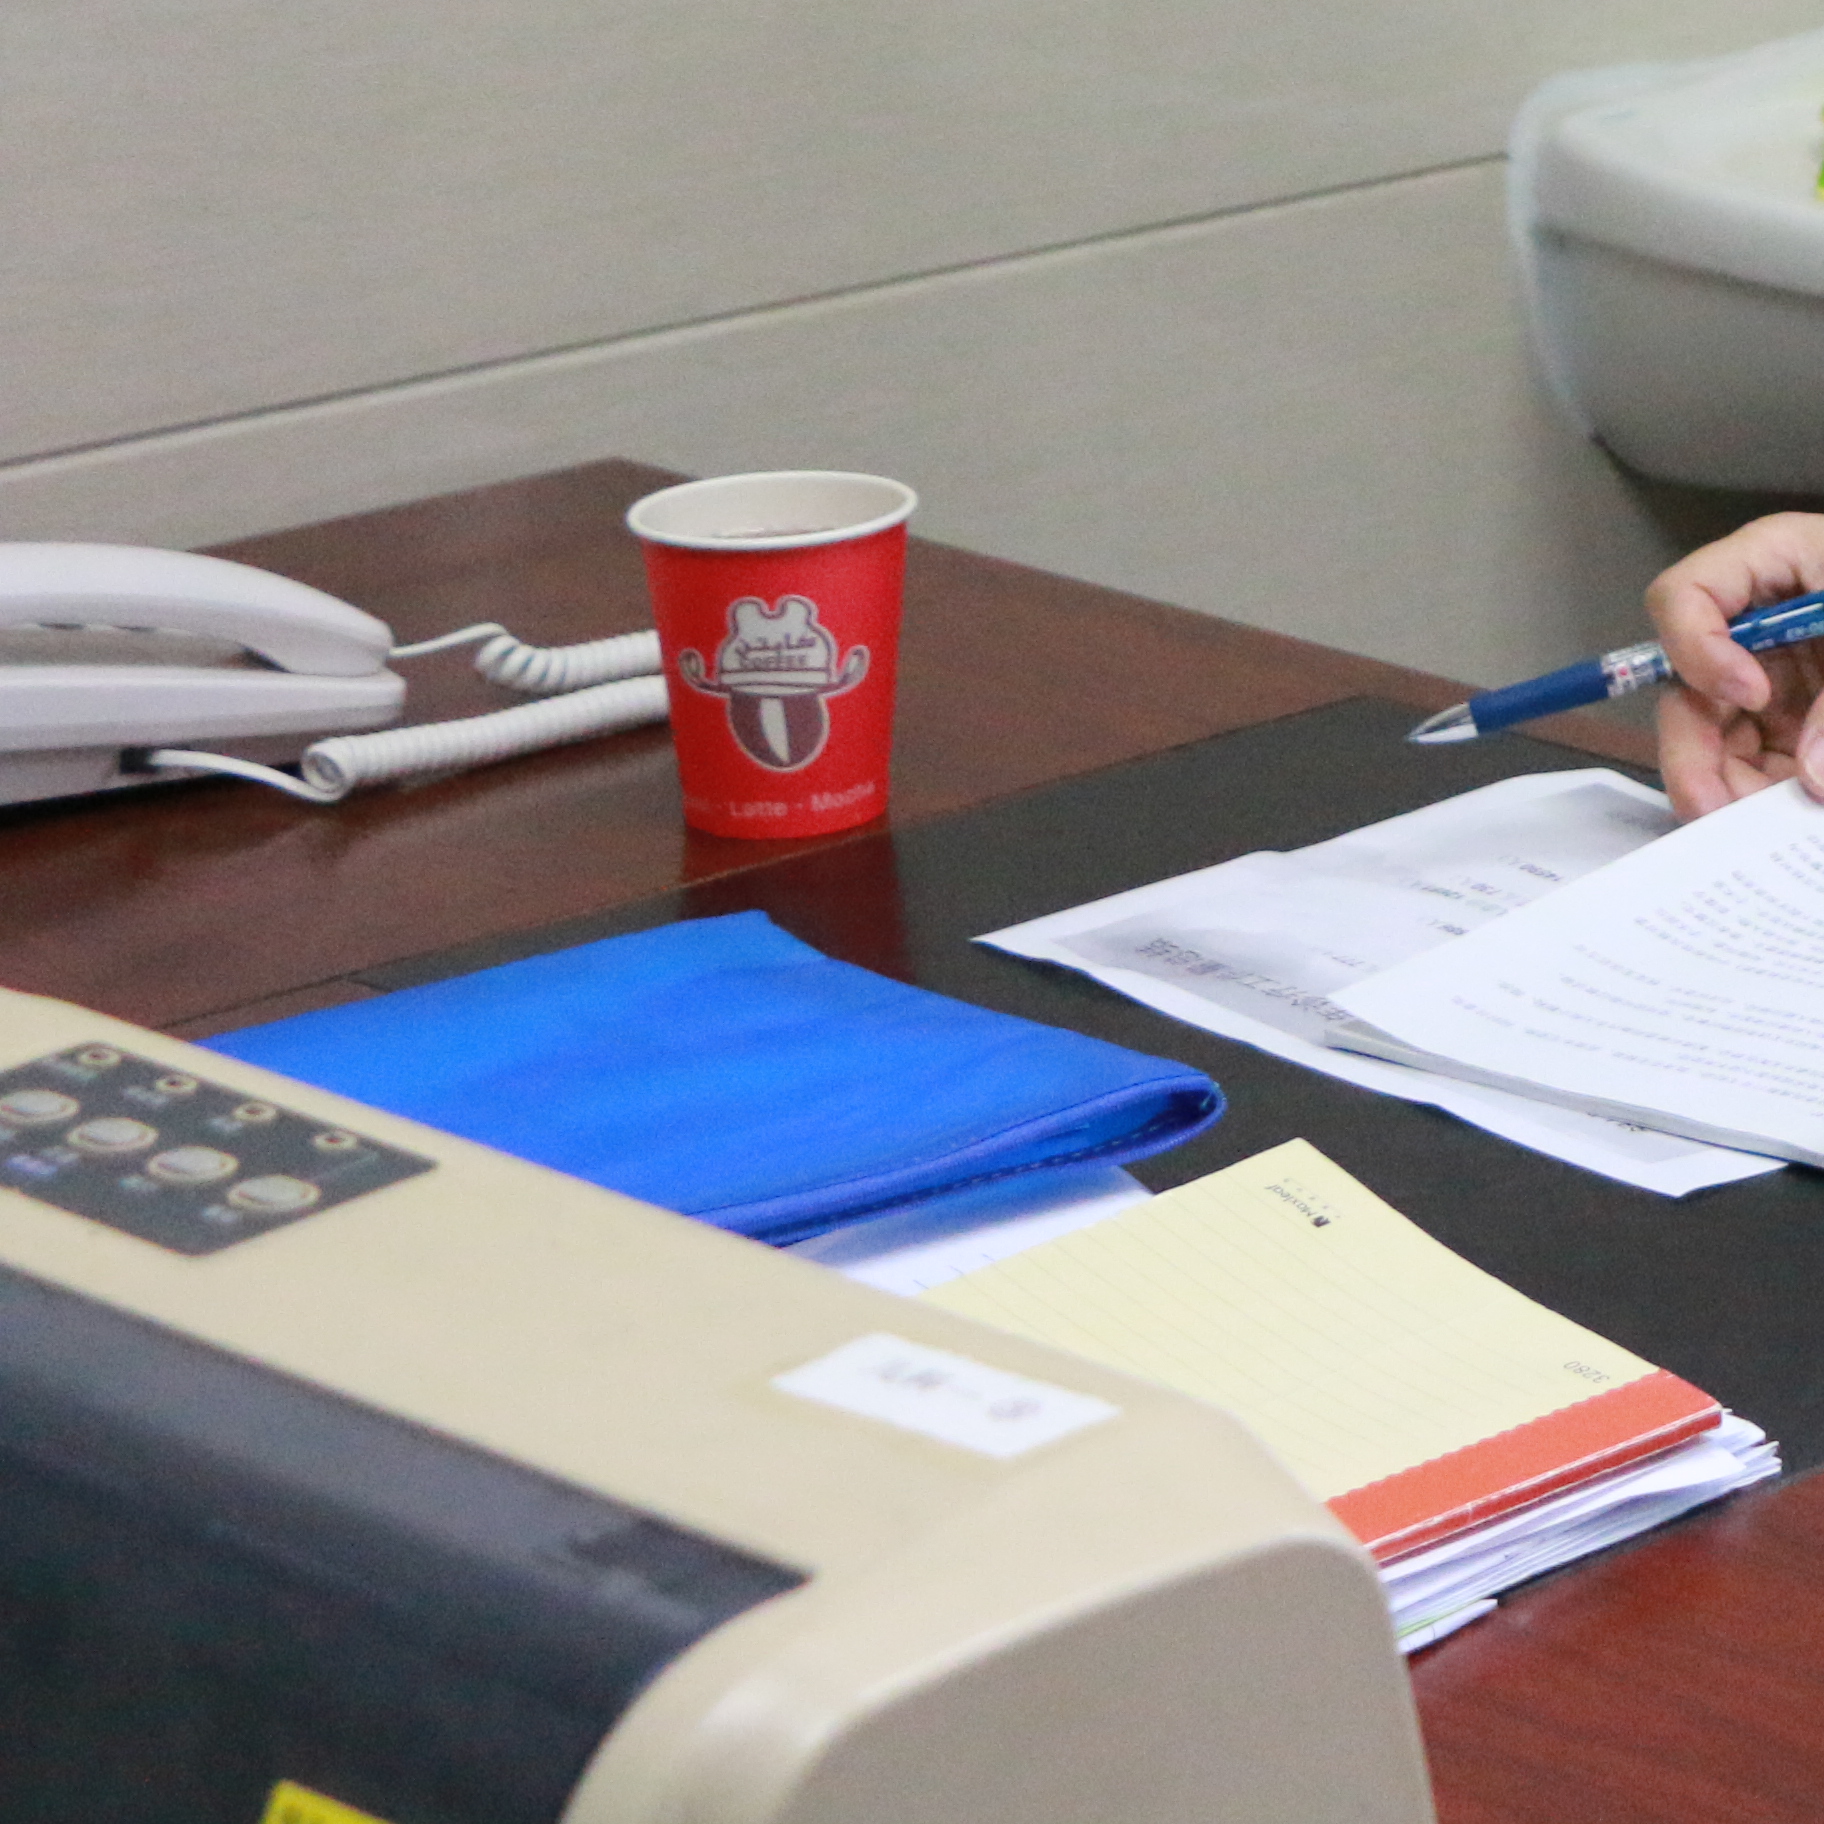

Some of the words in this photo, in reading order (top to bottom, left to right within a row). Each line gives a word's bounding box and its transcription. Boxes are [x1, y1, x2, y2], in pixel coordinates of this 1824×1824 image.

[729, 801, 788, 818] Latte
[1264, 1184, 1318, 1217] Maxleaf
[1563, 1361, 1610, 1383] 3280
